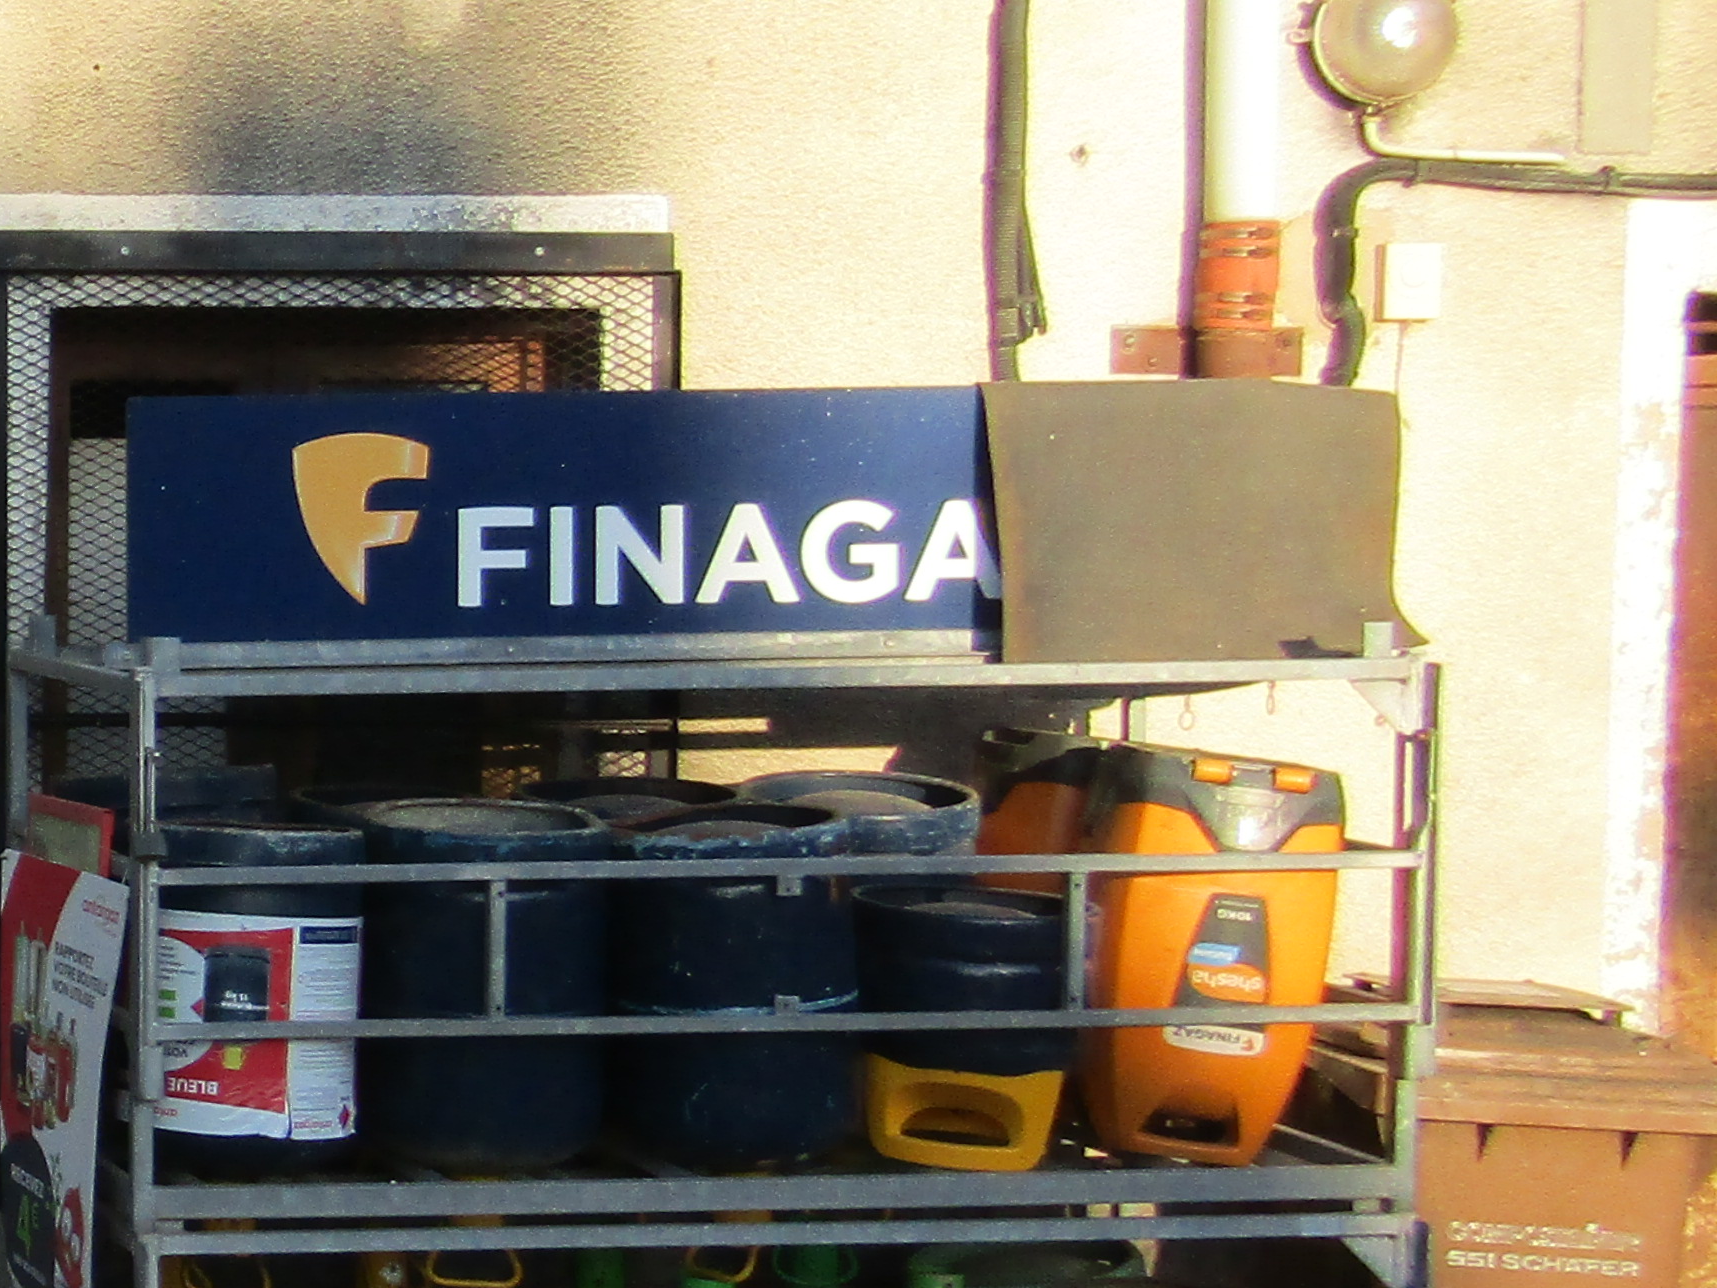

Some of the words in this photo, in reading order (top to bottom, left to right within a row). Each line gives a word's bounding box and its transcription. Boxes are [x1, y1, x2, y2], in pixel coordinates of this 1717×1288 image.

[457, 500, 1002, 607] FINAGA
[1193, 969, 1262, 992] shesha
[1172, 1026, 1242, 1044] FINAGAZ
[167, 1077, 219, 1096] BLEUE
